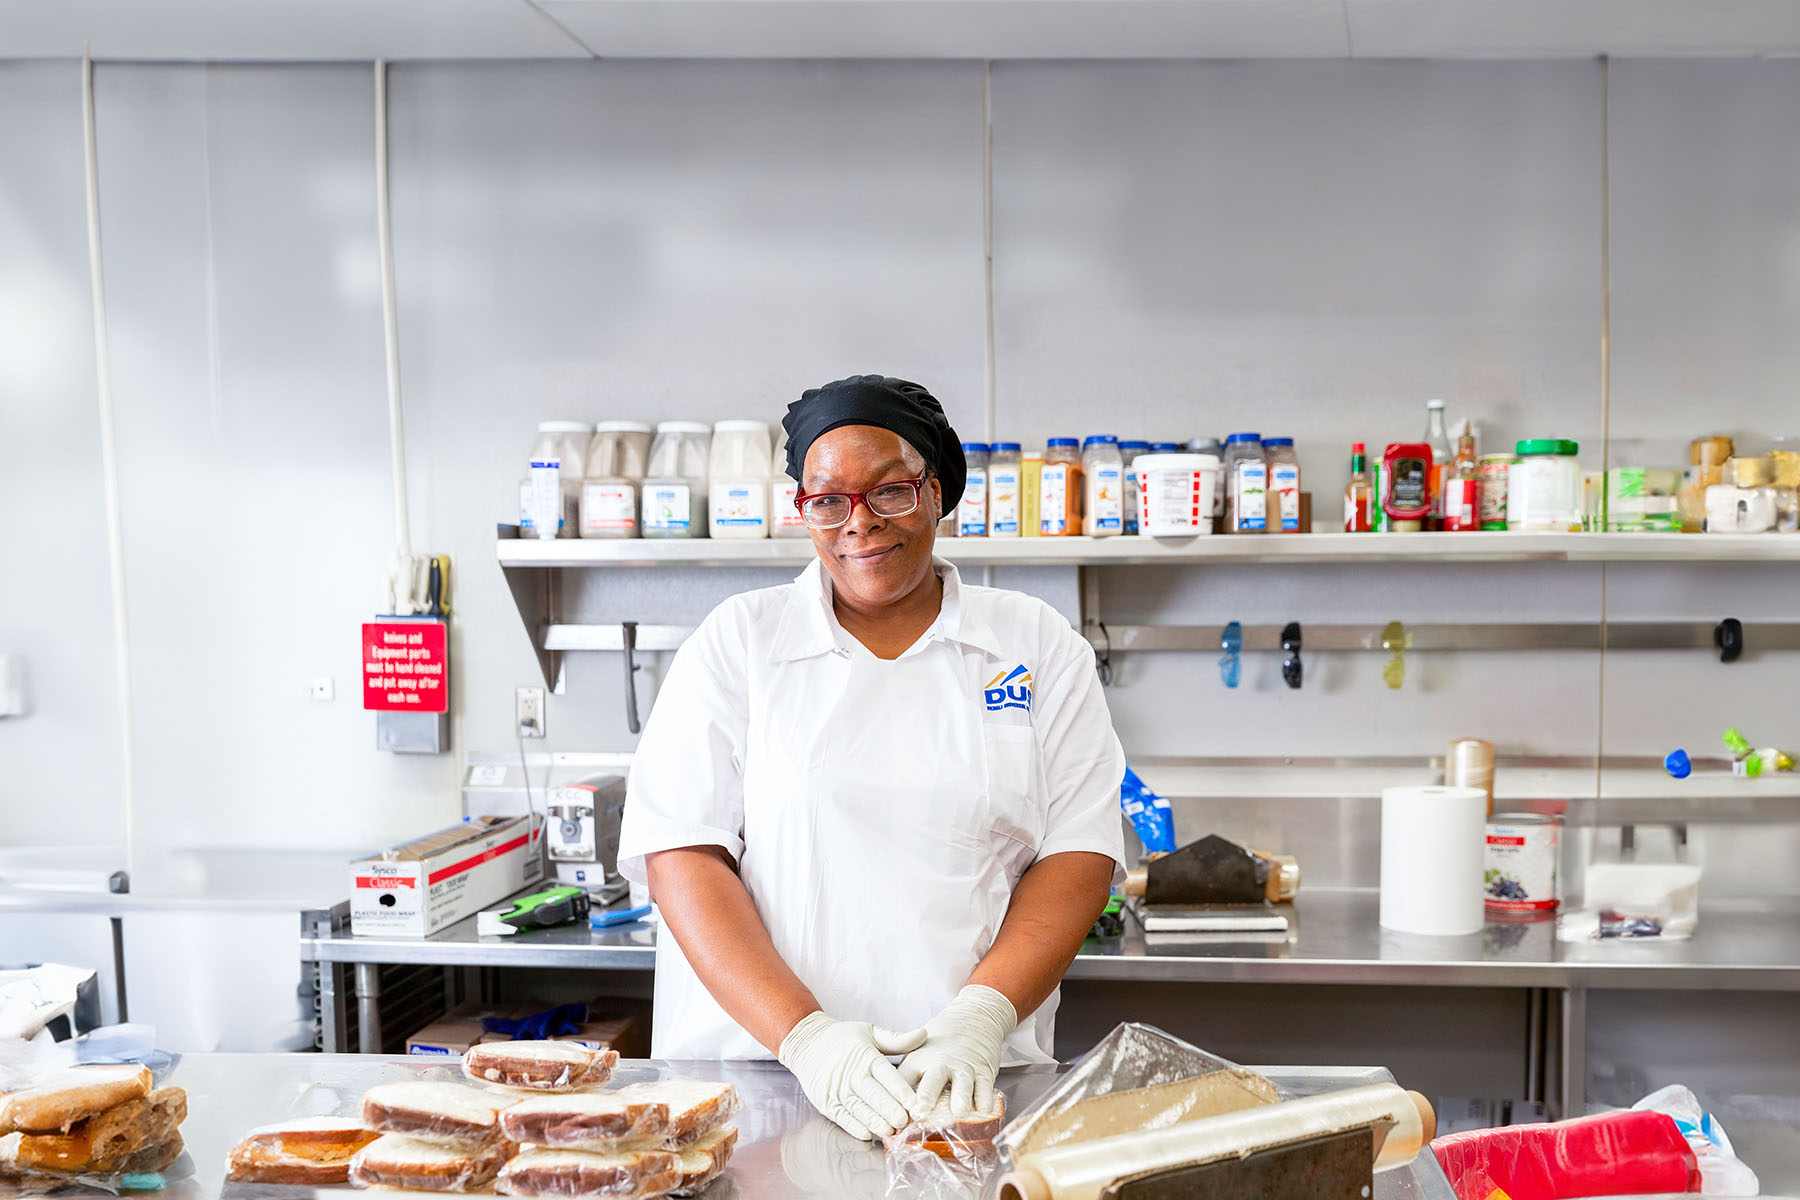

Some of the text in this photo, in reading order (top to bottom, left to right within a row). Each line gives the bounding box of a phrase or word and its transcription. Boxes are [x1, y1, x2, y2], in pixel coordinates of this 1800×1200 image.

[408, 632, 423, 645] and
[372, 646, 431, 661] Equipment parts
[365, 662, 384, 673] must
[385, 662, 394, 674] be
[395, 662, 413, 674] hand
[368, 676, 440, 691] and put away after
[387, 691, 405, 703] each
[372, 865, 397, 876] Sysco
